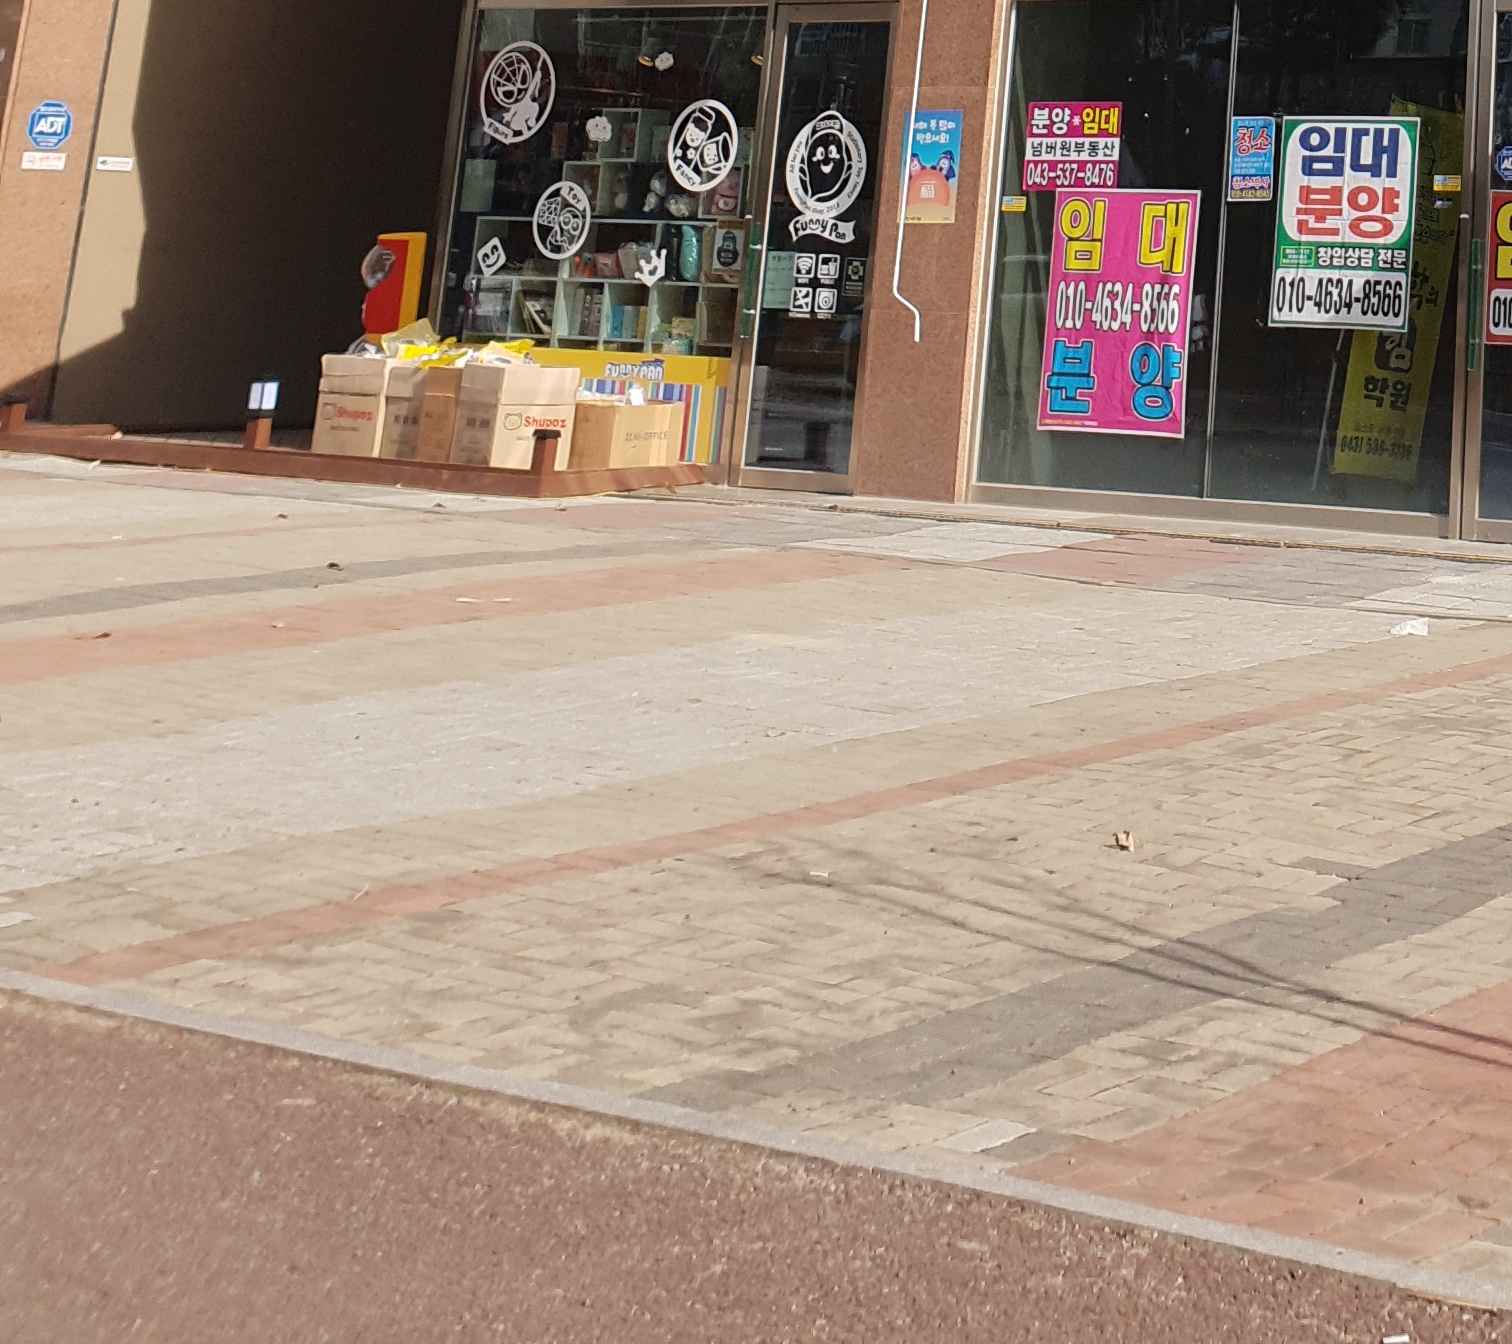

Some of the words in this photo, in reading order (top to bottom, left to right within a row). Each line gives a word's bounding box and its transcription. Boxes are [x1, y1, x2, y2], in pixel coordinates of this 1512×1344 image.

[33, 116, 66, 134] ADT
[1030, 140, 1116, 158] 넘버원부동산
[1235, 125, 1272, 157] 청소
[1298, 125, 1401, 180] 임대
[675, 162, 697, 187] Fancy
[1026, 162, 1114, 188] 043-537-8476
[1295, 184, 1401, 240] 분양
[1377, 248, 1407, 269] 전문
[1055, 279, 1181, 334] 010-4634-8566
[1275, 275, 1404, 319] 010-4634-8566
